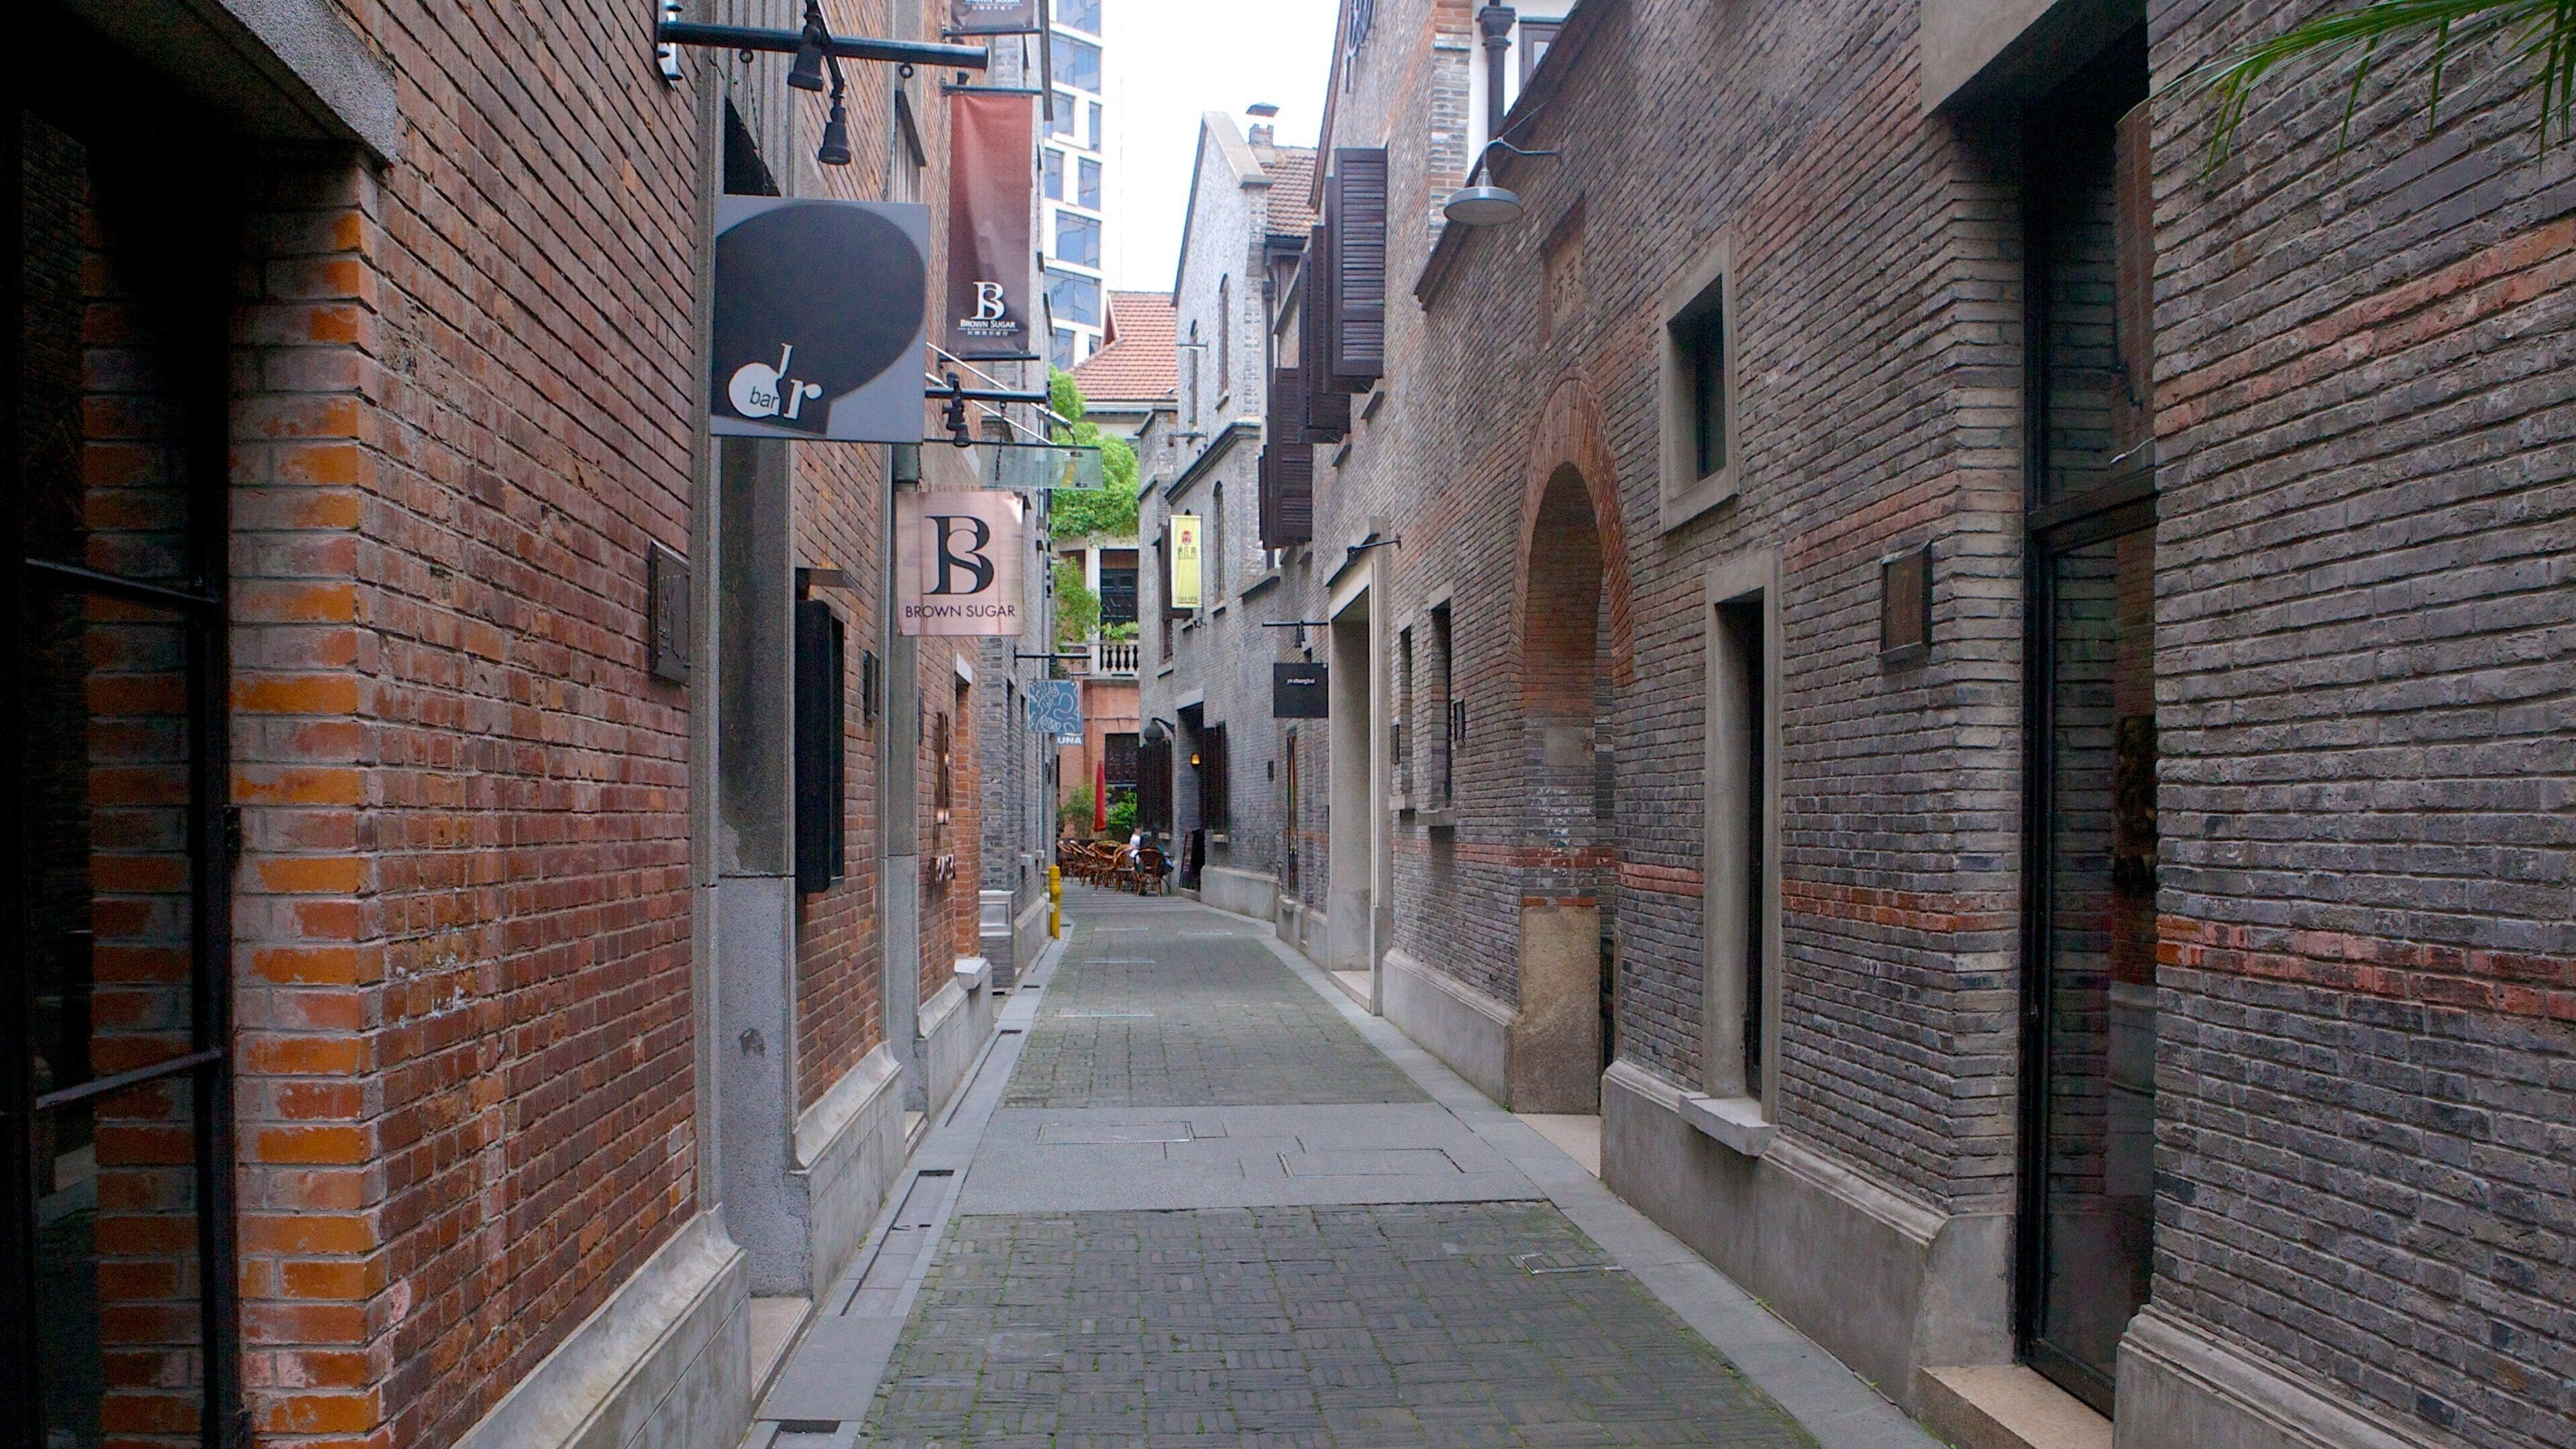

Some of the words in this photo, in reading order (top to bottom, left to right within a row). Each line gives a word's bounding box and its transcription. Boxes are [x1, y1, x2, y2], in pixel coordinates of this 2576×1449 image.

[960, 319, 989, 327] BROWN
[750, 386, 778, 409] bar
[906, 605, 961, 618] BROWN
[966, 604, 1015, 617] SUGAR
[1056, 737, 1082, 745] UNA
